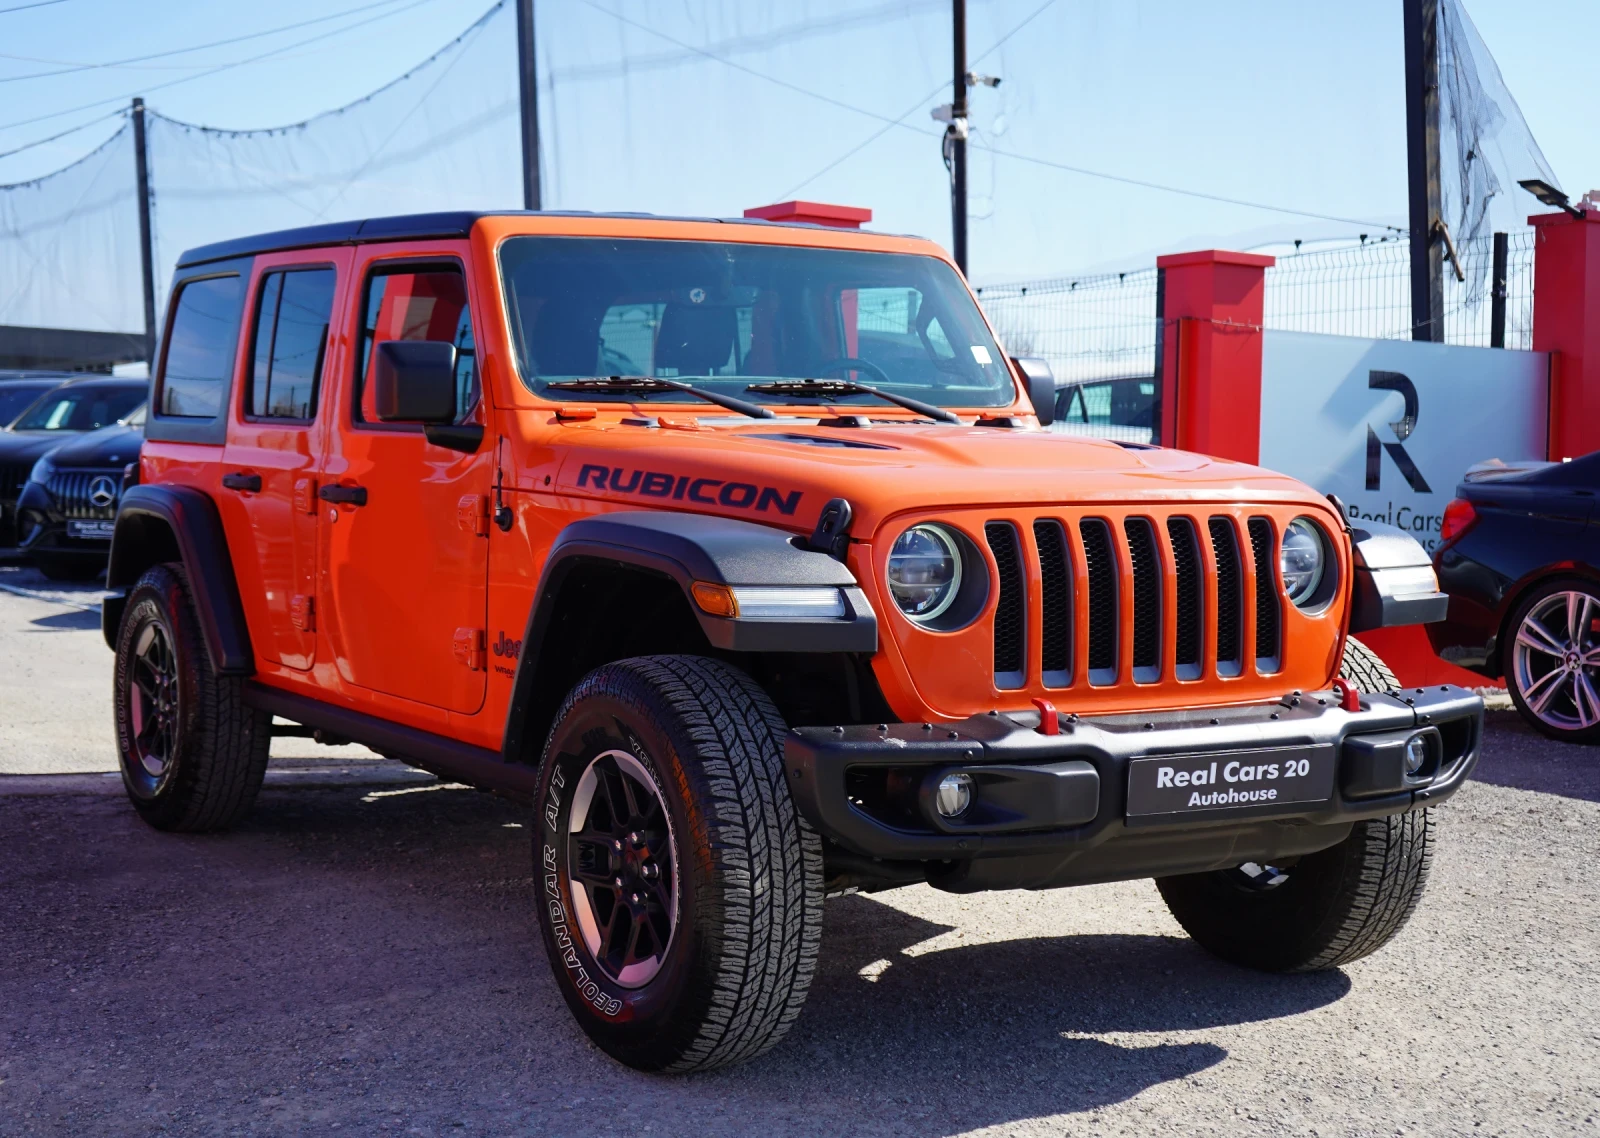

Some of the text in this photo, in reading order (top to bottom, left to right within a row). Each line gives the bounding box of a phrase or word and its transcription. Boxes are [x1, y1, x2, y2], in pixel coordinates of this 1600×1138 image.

[1365, 369, 1434, 494] R
[576, 463, 804, 516] RUBICON
[1396, 506, 1443, 532] Cars
[493, 631, 523, 660] Jee
[1156, 759, 1310, 789] Real Cars 20
[1187, 788, 1278, 807] Autohouse
[543, 764, 623, 1016] GEOLANDAR A/T
